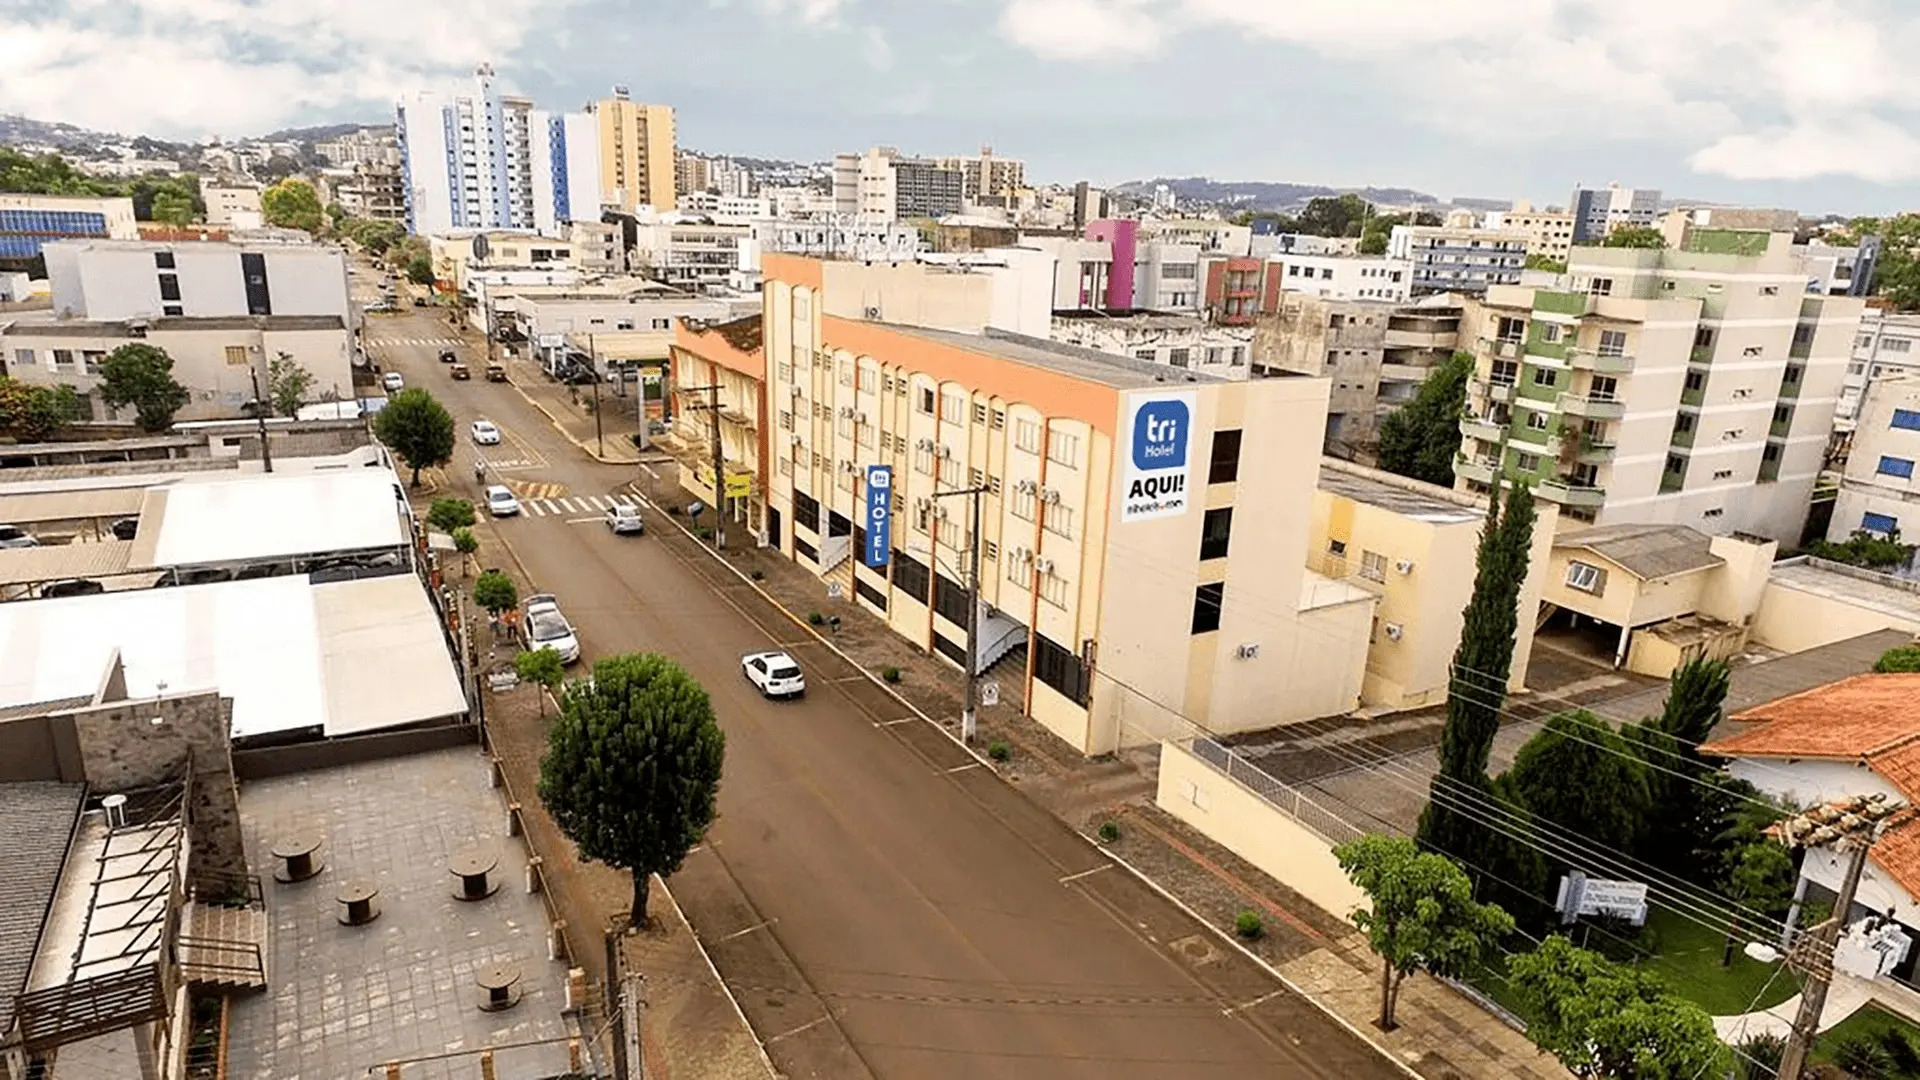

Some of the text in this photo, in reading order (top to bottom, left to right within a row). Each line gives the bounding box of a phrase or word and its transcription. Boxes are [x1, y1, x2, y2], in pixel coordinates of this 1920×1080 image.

[1146, 413, 1176, 442] tri
[1128, 474, 1185, 499] AQUI!
[872, 492, 886, 562] HOTEL
